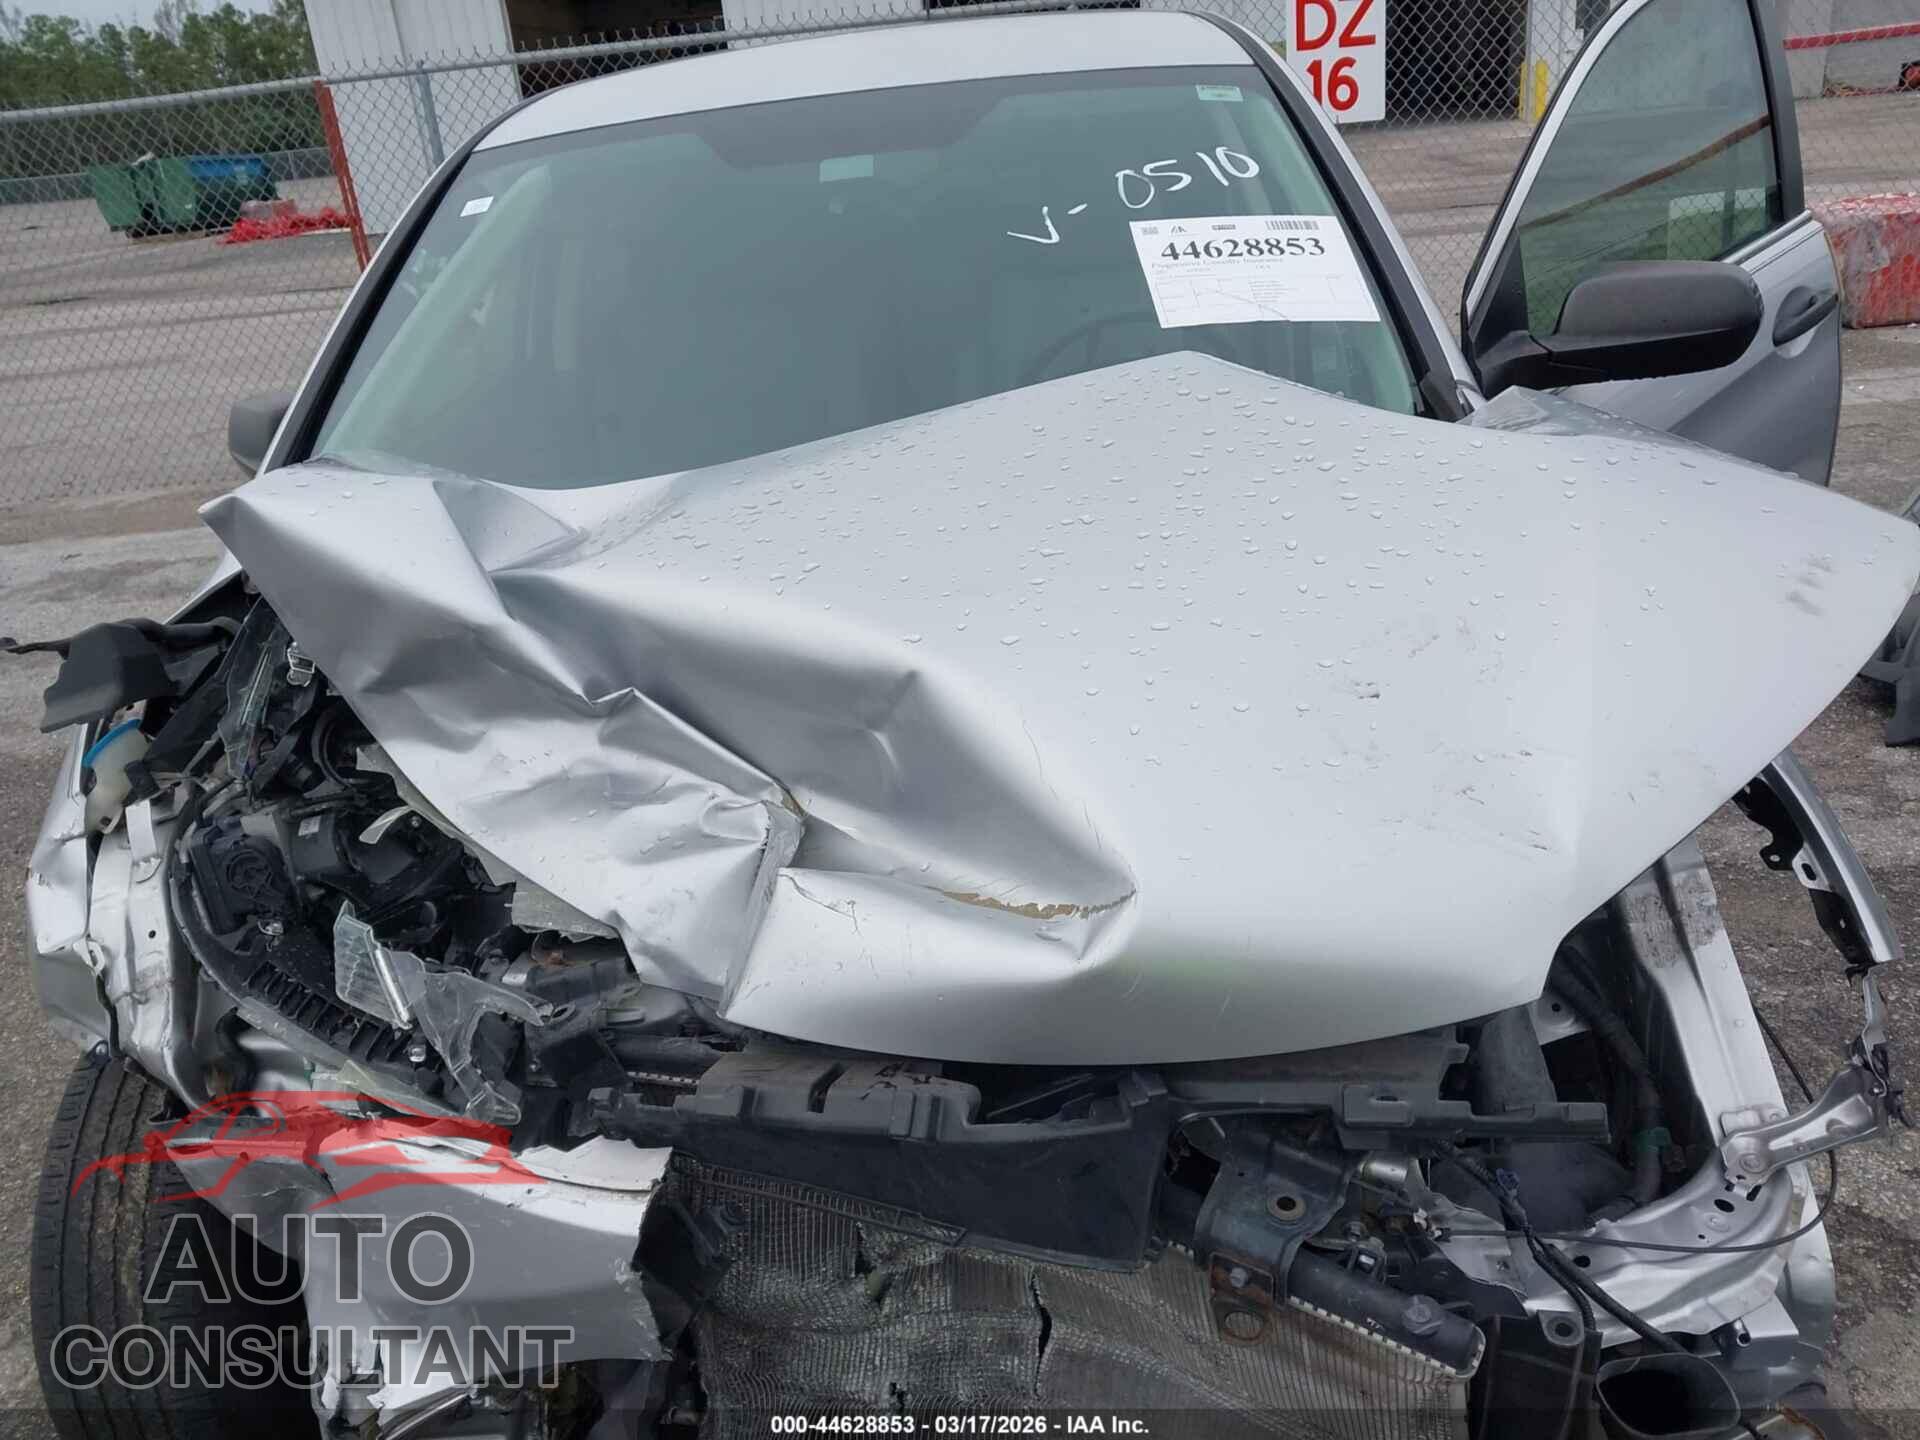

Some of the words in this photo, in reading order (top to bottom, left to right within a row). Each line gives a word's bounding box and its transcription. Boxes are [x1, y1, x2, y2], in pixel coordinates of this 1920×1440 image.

[1296, 0, 1376, 51] DZ
[1306, 56, 1359, 112] 16
[1115, 146, 1259, 209] 0510
[1161, 237, 1326, 261] 44628853
